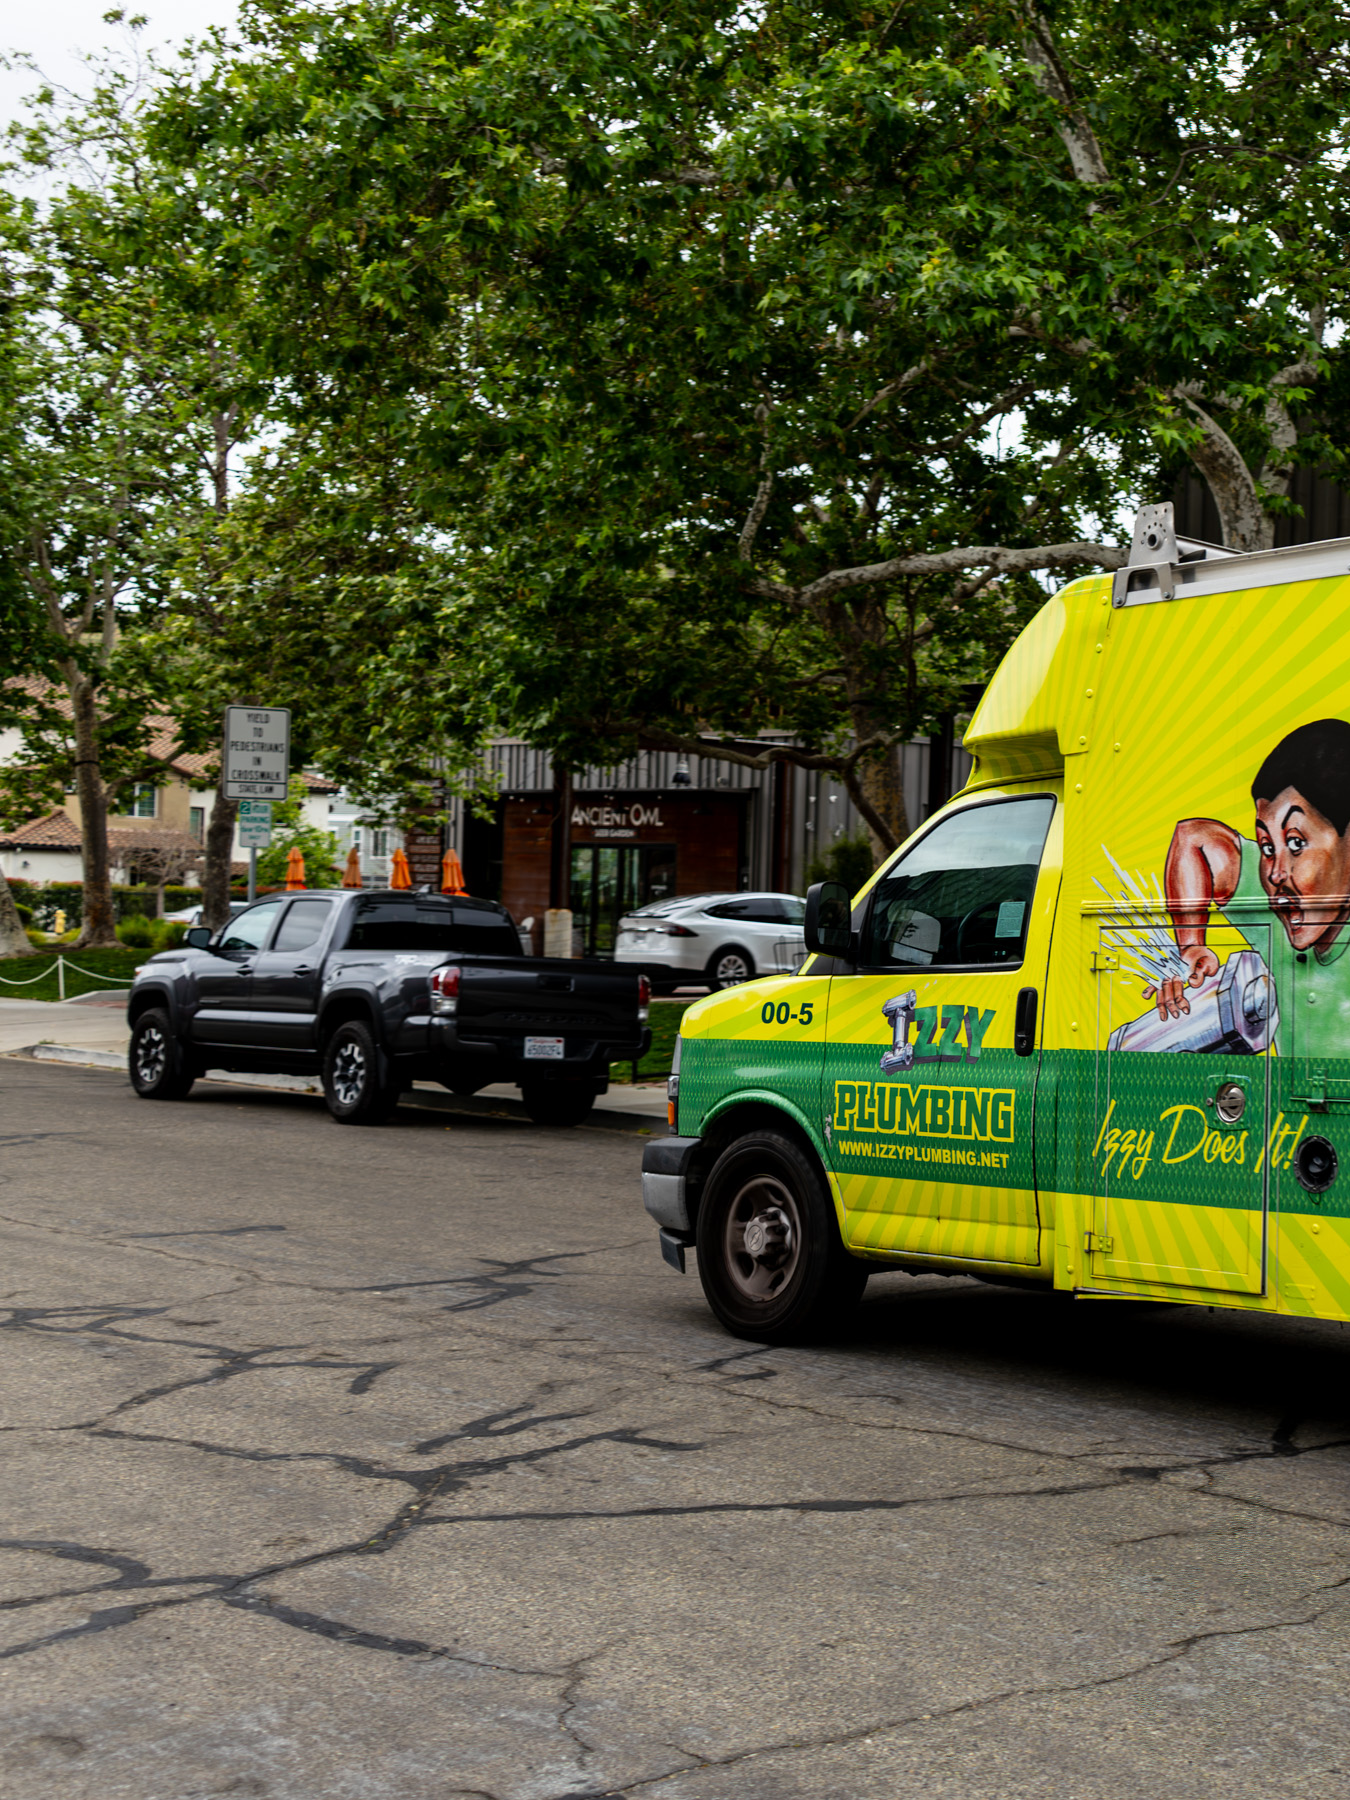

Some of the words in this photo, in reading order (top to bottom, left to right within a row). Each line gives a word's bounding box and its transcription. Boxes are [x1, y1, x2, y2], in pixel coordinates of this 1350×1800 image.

[246, 713, 270, 724] YIELD
[253, 727, 263, 738] TO
[230, 741, 285, 753] PEDESTRIANS
[252, 756, 262, 766] IN
[231, 769, 281, 781] CROSSWALK
[260, 785, 274, 794] LAW
[241, 802, 251, 814] 2
[629, 803, 664, 827] OWL
[761, 1001, 814, 1025] 00-5
[880, 989, 997, 1076] IZZY
[834, 1080, 1016, 1142] PLUMBING
[1092, 1099, 1154, 1180] Izzy
[1159, 1104, 1249, 1165] Does
[1253, 1110, 1309, 1174] It!
[838, 1140, 1009, 1168] WWW.IZZYPLUMBING.NET
